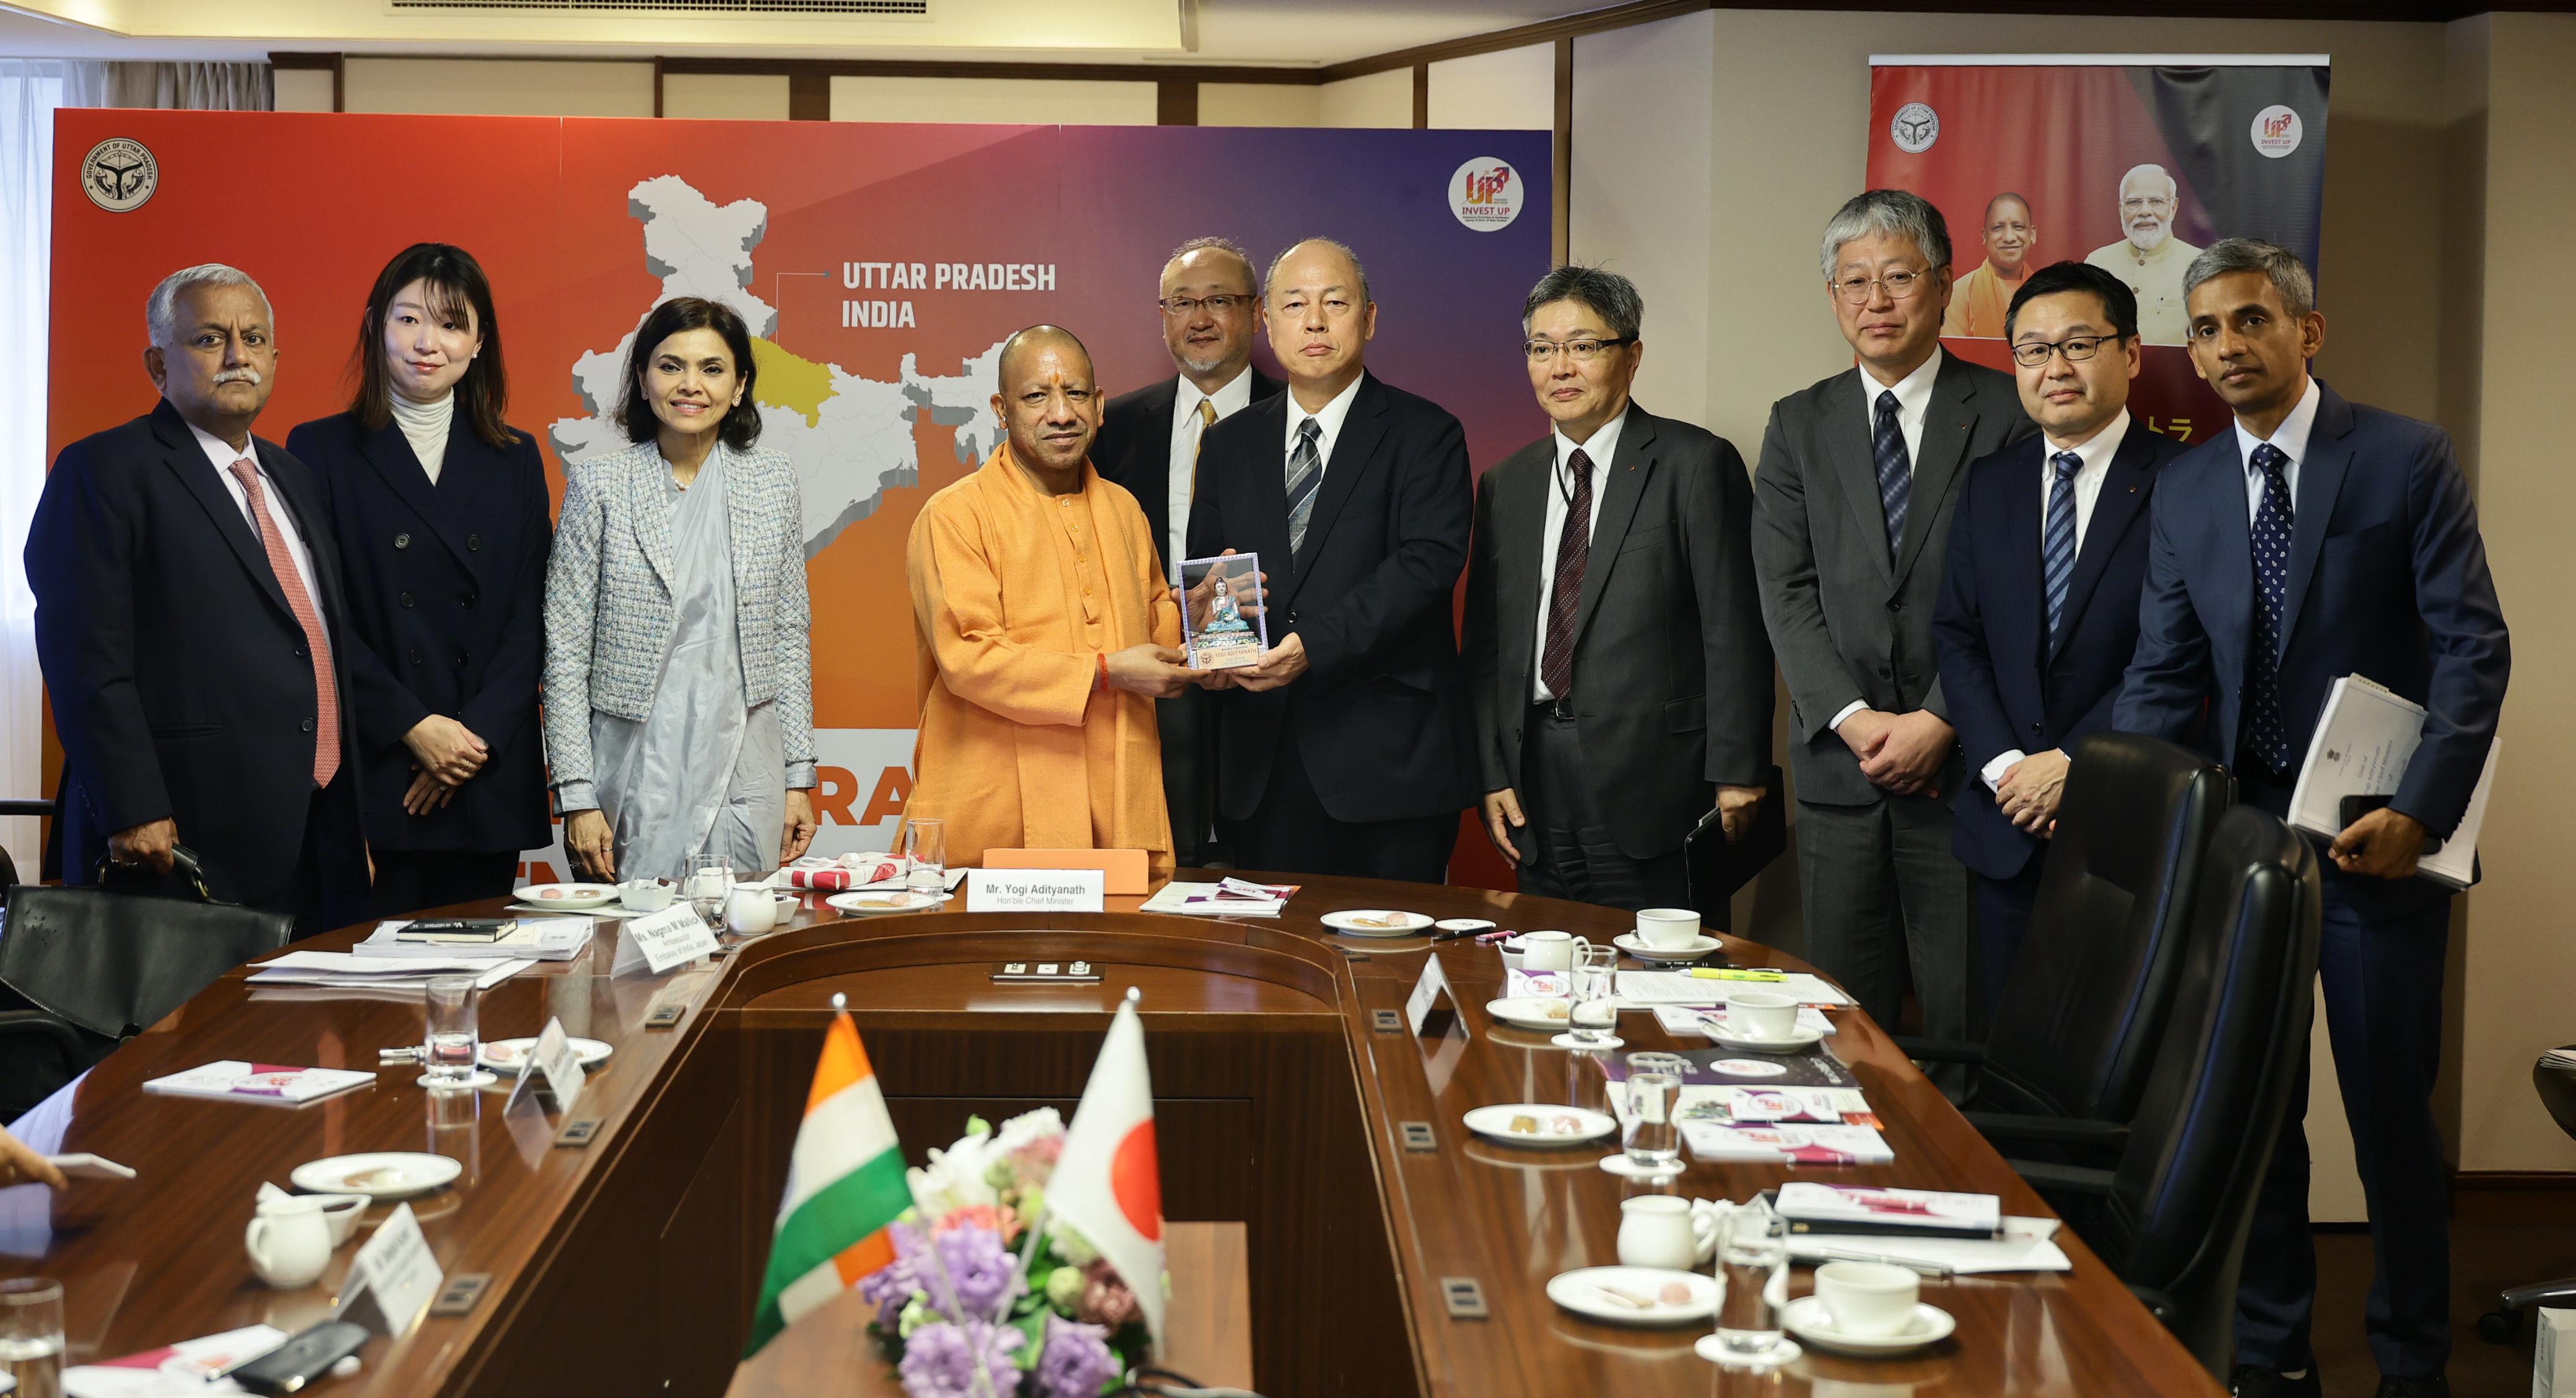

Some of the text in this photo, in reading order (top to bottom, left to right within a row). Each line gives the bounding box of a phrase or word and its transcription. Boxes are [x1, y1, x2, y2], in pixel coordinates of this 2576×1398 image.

[86, 144, 111, 179] GOVERNMENT
[122, 143, 141, 154] UTTAR
[139, 153, 154, 180] PRADESH
[1466, 167, 1510, 204] UP
[1497, 207, 1510, 215] UP
[843, 262, 1056, 291] UTTAR PRADESH
[842, 300, 916, 328] INDIA
[1227, 648, 1256, 657] ADITYANATH
[986, 884, 1086, 897] Mr. Yogi Adityanath
[996, 896, 1074, 906] Hon'ble Chief Minister
[635, 932, 648, 943] Ms.
[646, 925, 672, 938] Nagma
